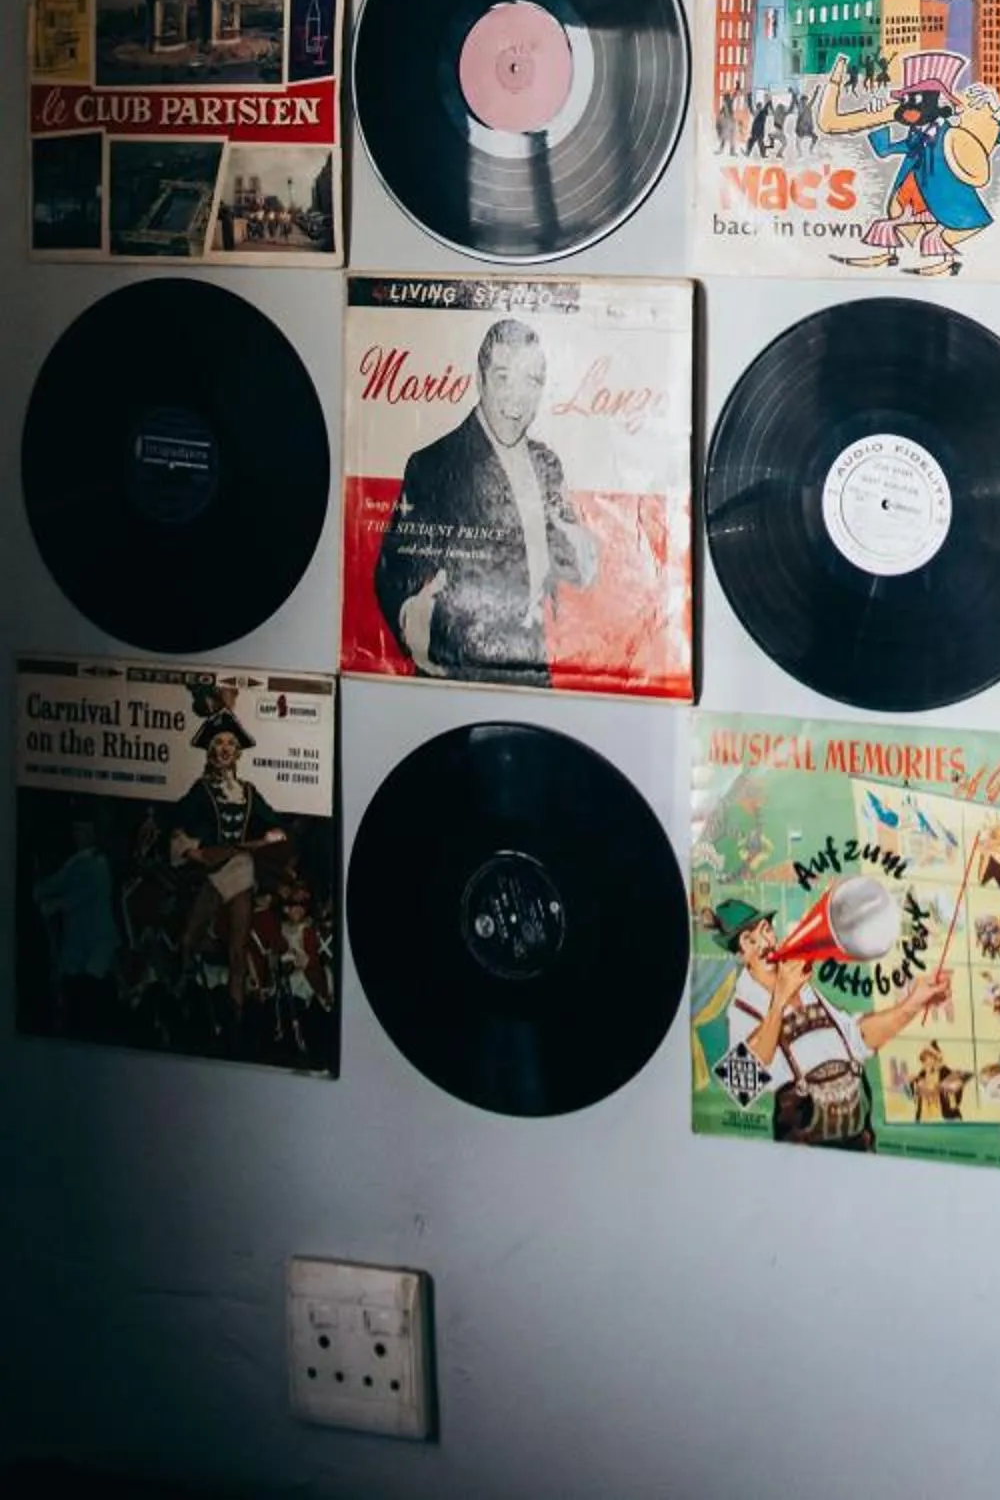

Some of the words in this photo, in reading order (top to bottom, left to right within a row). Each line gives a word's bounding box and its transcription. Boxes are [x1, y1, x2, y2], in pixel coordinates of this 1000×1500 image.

[39, 86, 66, 126] le
[74, 97, 151, 124] CLUB
[158, 96, 321, 126] PARISIEN
[718, 163, 858, 212] Mac's
[712, 213, 760, 236] bac
[774, 215, 794, 236] in
[803, 219, 863, 238] town
[388, 283, 457, 306] LIVING
[473, 286, 553, 307] STEREO
[359, 344, 473, 406] Mario
[837, 443, 884, 477] AUDIO
[895, 444, 946, 507] FIDELITY
[396, 521, 454, 538] STUDENT
[26, 692, 121, 726] Carnival
[127, 700, 187, 732] Time
[26, 731, 52, 751] on
[59, 728, 96, 757] the
[102, 734, 170, 764] Rhine
[708, 729, 817, 772] MUSICAL
[823, 739, 966, 783] MEMORIES
[955, 764, 987, 802] of
[794, 836, 845, 891] Auf
[844, 841, 908, 880] zum
[818, 891, 930, 997] Oktoberfest
